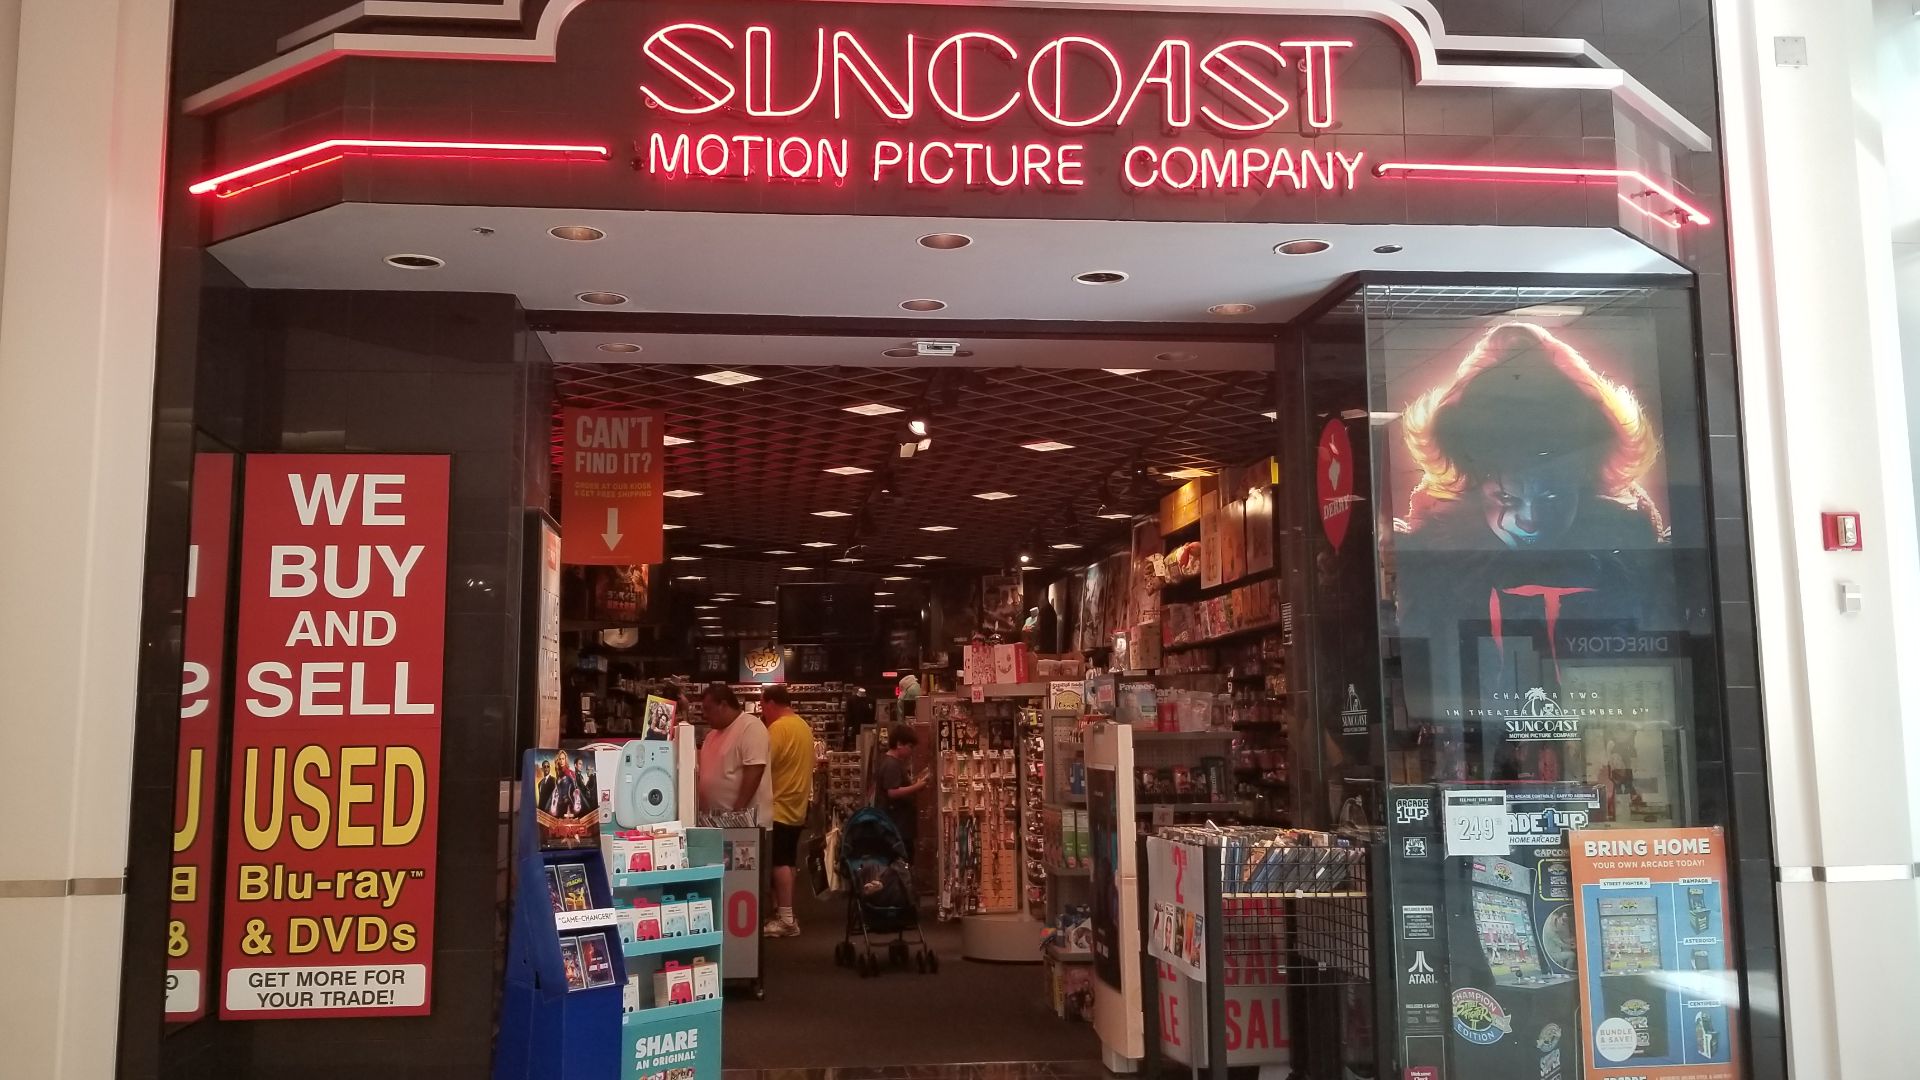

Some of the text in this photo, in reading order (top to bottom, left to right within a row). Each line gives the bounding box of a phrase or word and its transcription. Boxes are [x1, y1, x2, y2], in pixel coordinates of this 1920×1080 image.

[640, 23, 1353, 130] SUNCOAST
[649, 132, 1364, 191] MOTION PICTURE COMPANY
[576, 415, 653, 449] CAN'T
[575, 451, 653, 475] FIND IT?
[287, 473, 406, 526] WE
[269, 544, 426, 599] BUY
[285, 610, 397, 647] AND
[1489, 584, 1598, 686] IT
[746, 650, 780, 669] POP!
[245, 661, 435, 718] SELL
[1570, 692, 1598, 700] TWO
[1505, 720, 1579, 732] SUNCOAST
[243, 745, 426, 850] USED
[1397, 799, 1429, 808] ARCADE
[1532, 836, 1559, 844] ARCADE
[1584, 837, 1711, 858] BRING HOME
[1592, 859, 1705, 869] YOUR OWN ARCADE TODAY!
[241, 916, 417, 955] & DVDs
[249, 969, 406, 988] GET MORE FOR
[1408, 973, 1435, 985] ATARI
[257, 989, 395, 1008] YOUR TRADE!
[1457, 1024, 1495, 1041] EDITION
[1600, 1028, 1632, 1036] BUNDLE
[635, 1028, 698, 1059] SHARE
[636, 1050, 696, 1071] AN ORIGINAL
